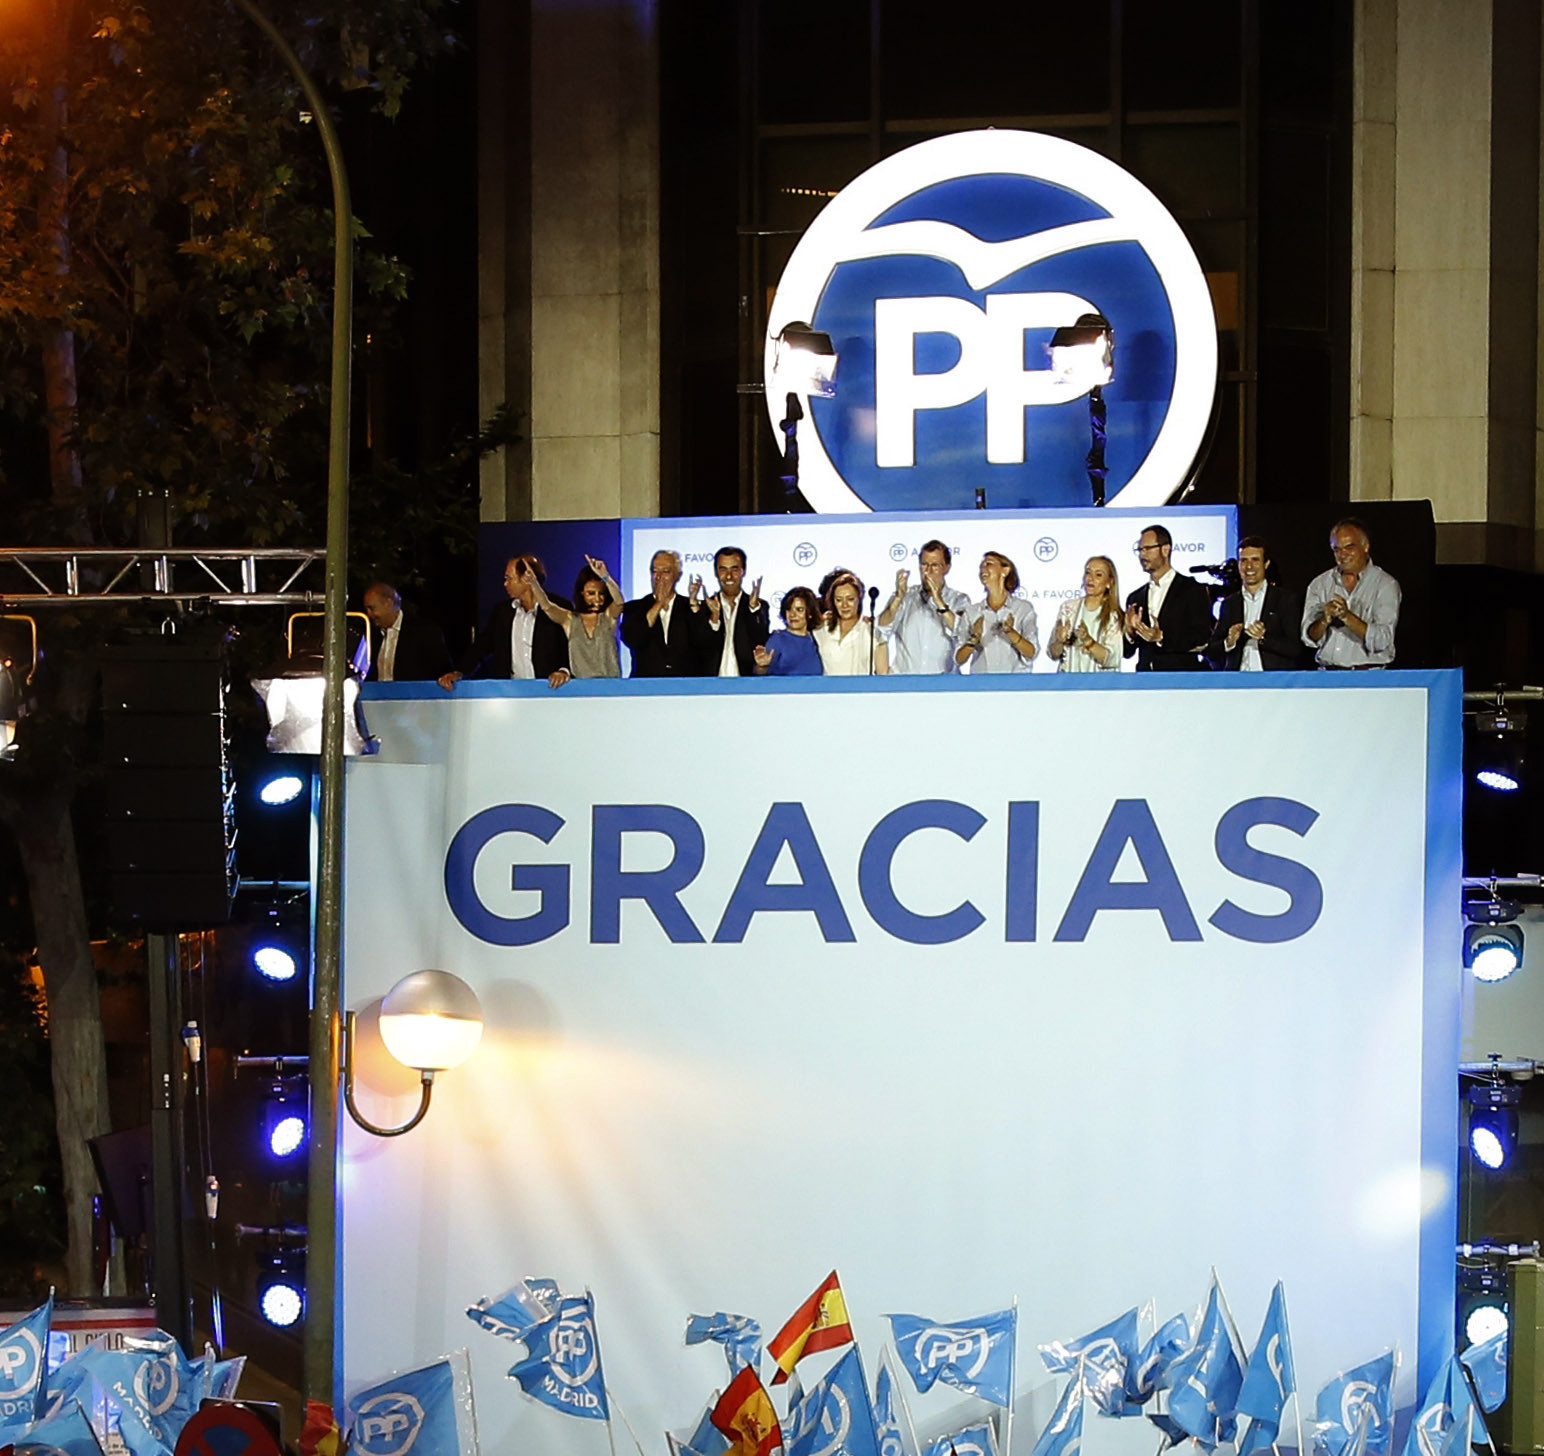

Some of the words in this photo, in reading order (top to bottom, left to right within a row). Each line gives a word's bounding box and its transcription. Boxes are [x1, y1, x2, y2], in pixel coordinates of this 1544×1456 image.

[875, 292, 1109, 468] PP
[444, 796, 1324, 946] GRACIAS
[928, 1340, 973, 1368] PP
[543, 1375, 599, 1409] MADRID
[362, 1412, 410, 1443] PP
